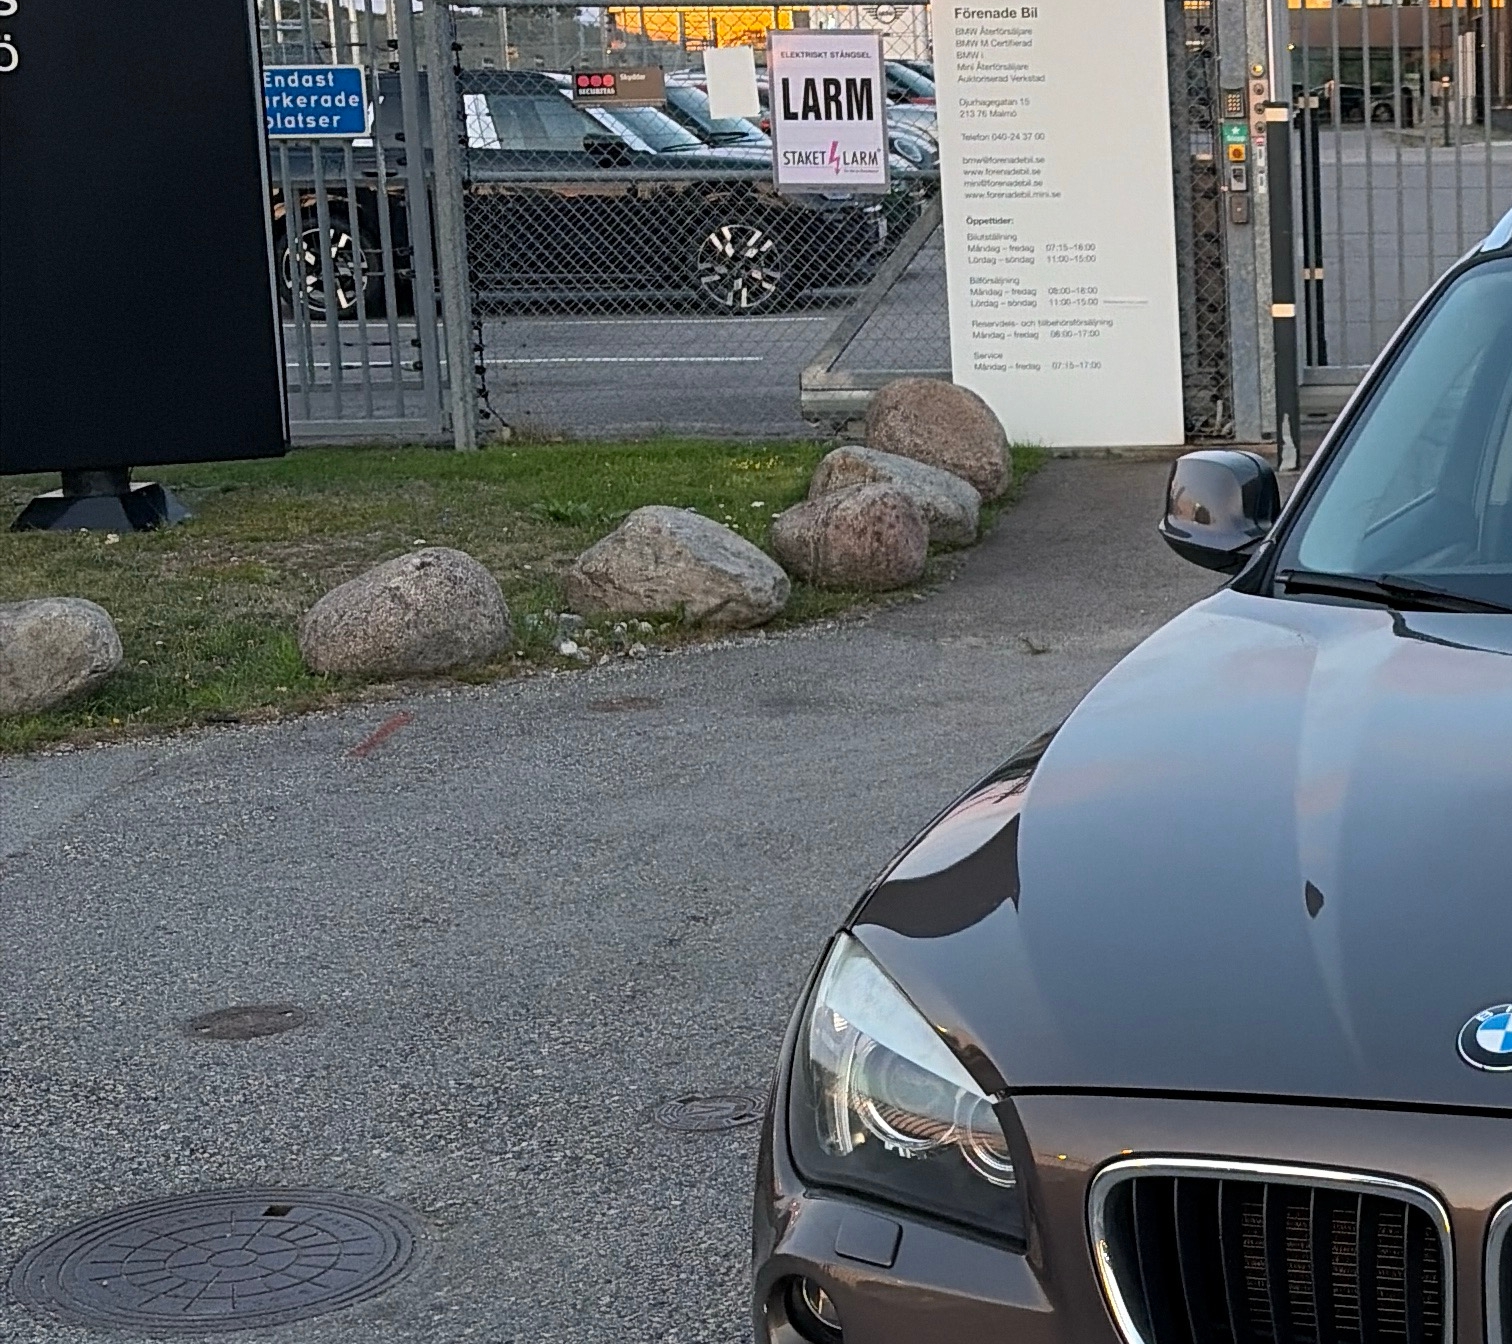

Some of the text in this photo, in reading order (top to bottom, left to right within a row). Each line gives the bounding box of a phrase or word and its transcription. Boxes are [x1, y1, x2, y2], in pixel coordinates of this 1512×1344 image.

[954, 7, 1039, 19] Förenade Bil
[780, 51, 828, 59] ELEKTRISKT
[264, 71, 334, 87] Endast
[265, 91, 360, 108] rkerade
[781, 77, 874, 121] LARM
[960, 110, 975, 118] 213
[783, 150, 879, 166] STAKET LARM
